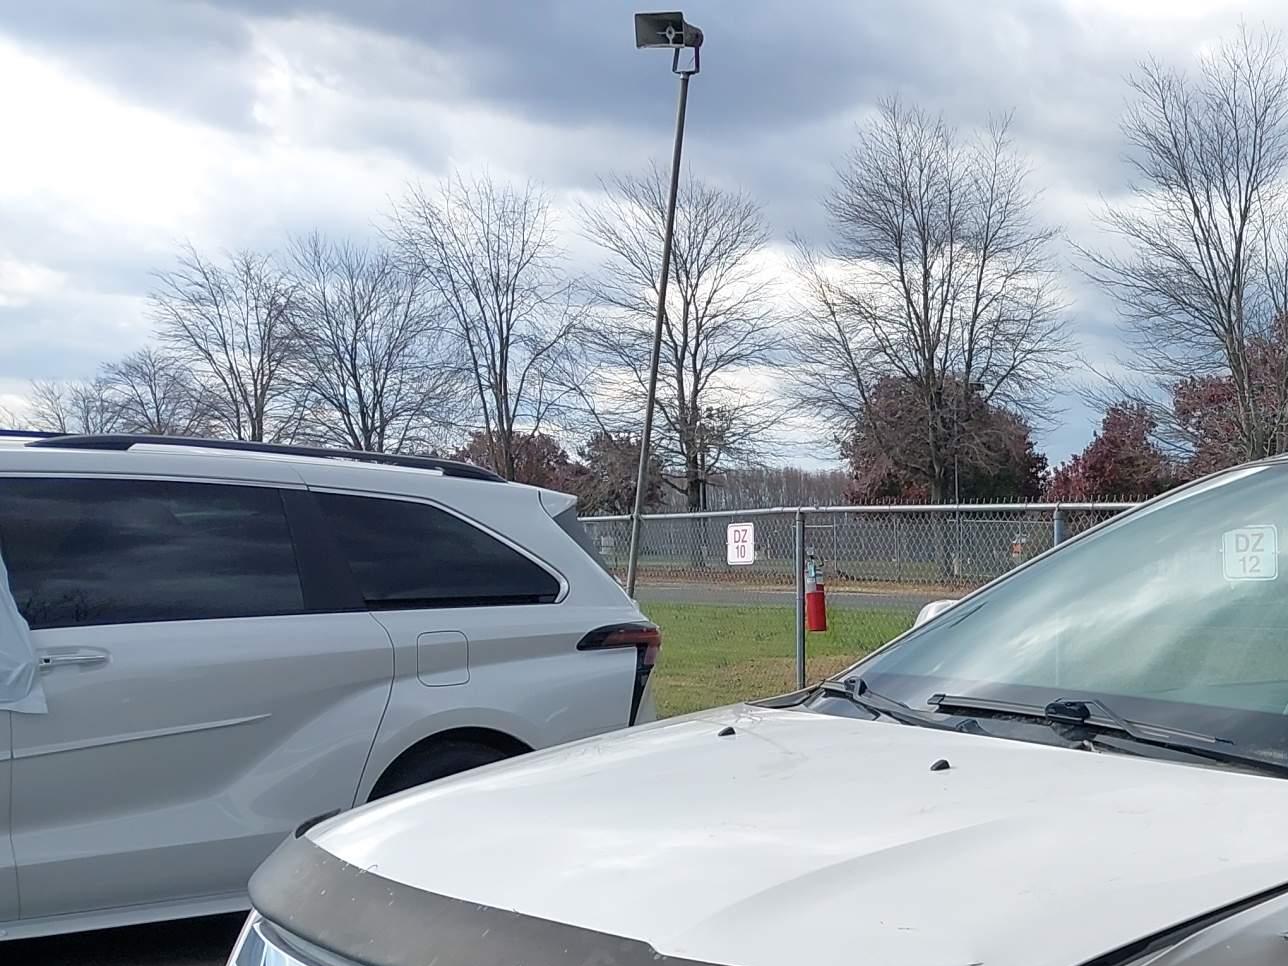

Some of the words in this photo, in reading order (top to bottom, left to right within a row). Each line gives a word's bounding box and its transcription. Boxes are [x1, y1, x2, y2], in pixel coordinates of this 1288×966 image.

[733, 528, 748, 544] DZ
[1234, 532, 1265, 553] DZ
[735, 544, 746, 559] 10
[1238, 554, 1261, 574] 12
